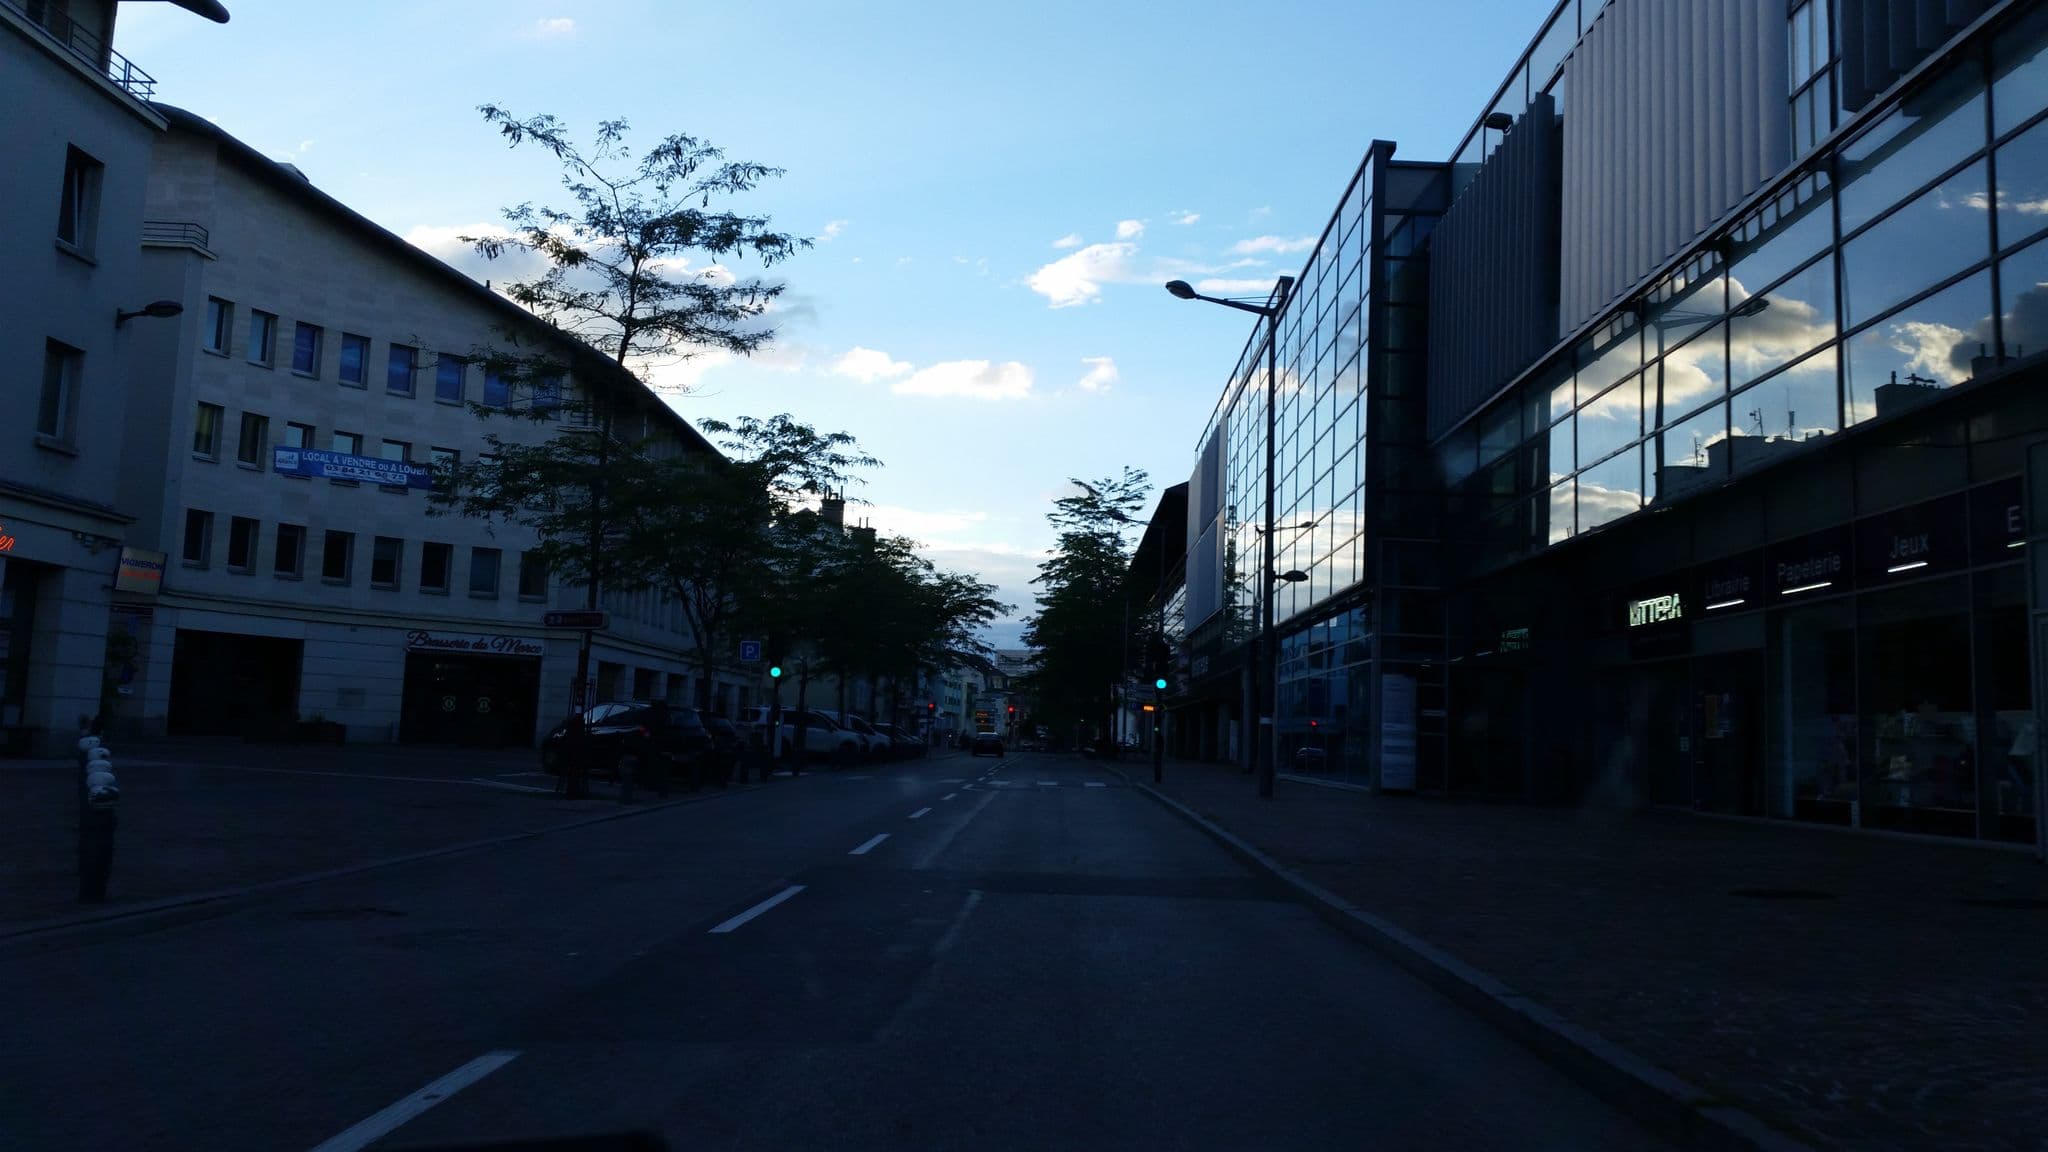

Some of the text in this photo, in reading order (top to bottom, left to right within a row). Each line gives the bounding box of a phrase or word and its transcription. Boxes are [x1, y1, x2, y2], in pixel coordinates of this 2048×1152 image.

[302, 451, 331, 464] LOCAL
[342, 456, 376, 469] VENDRE
[1888, 532, 1930, 560] Jeux
[121, 557, 163, 570] VIGNERON
[1777, 551, 1841, 585] Papeterie
[746, 646, 755, 656] P
